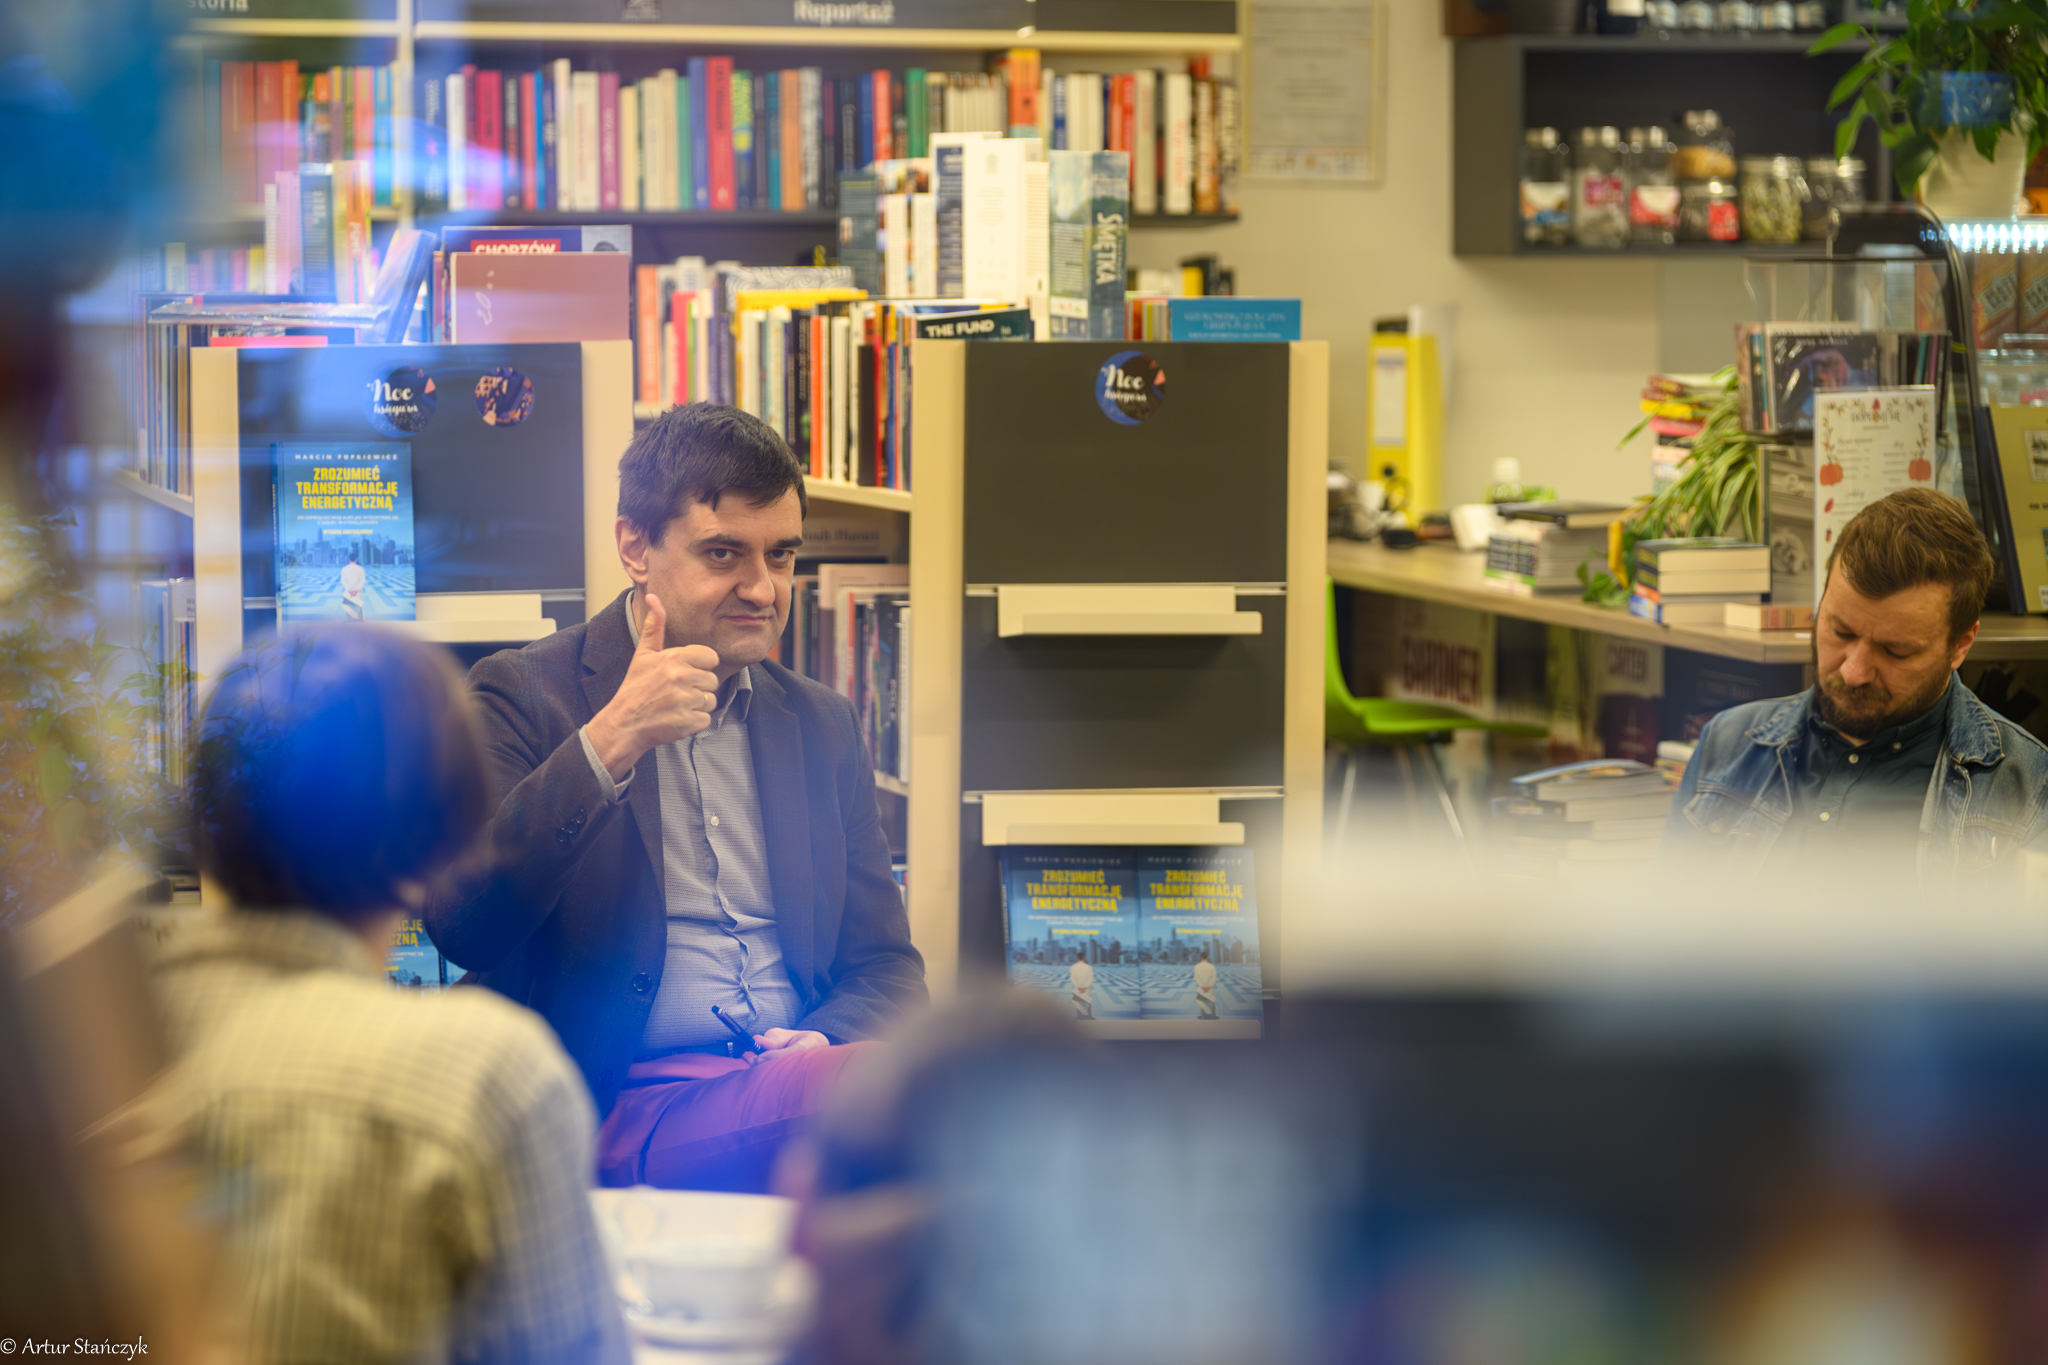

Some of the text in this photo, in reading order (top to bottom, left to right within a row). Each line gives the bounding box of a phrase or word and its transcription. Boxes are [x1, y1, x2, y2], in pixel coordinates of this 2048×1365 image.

[793, 0, 895, 26] Reportaż
[1092, 212, 1124, 285] SMĘTKA
[925, 322, 955, 337] THE
[956, 319, 995, 336] FUND
[1101, 363, 1145, 390] Noc
[366, 378, 413, 402] Noc
[294, 453, 398, 461] MARCIN POPKIEWICZ
[313, 465, 381, 481] ZROZUMIEĆ
[296, 481, 398, 497] TRANSFORMACJĘ
[302, 496, 393, 512] ENERGETYCZNĄ
[1042, 868, 1105, 884] ZROZUMIEĆ
[1164, 868, 1227, 884] ZROZUMIEĆ
[1026, 883, 1123, 900] TRANSFORMACJĘ
[1149, 882, 1244, 900] TRANSFORMACJĘ
[1032, 896, 1118, 914] ENERGETYCZNĄ
[1155, 896, 1239, 914] ENERGETYCZNĄ
